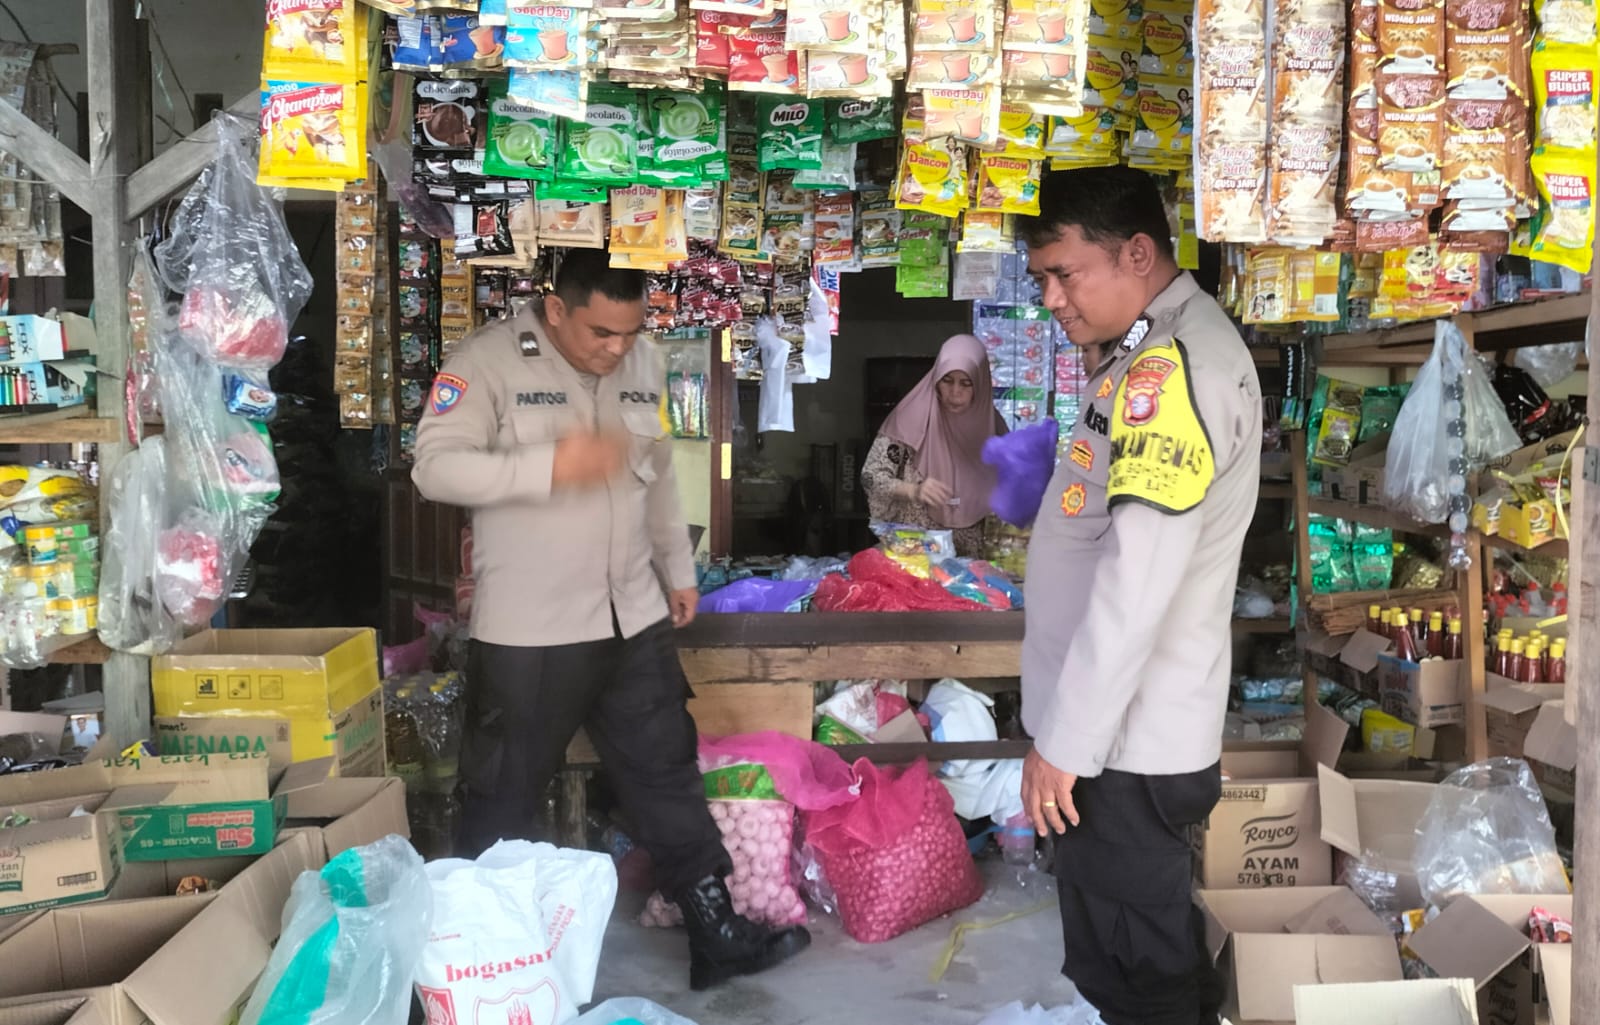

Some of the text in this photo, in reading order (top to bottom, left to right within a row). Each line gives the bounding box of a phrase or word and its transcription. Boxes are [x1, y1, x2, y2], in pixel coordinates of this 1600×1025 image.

[513, 6, 570, 20] Good Day
[1145, 25, 1184, 40] Dancow
[1311, 60, 1335, 71] JAHE
[1550, 71, 1587, 81] SUPER
[1548, 82, 1591, 92] BUBUR
[962, 89, 985, 103] Day
[1141, 100, 1179, 115] Dancow
[773, 110, 805, 122] MILO
[909, 151, 949, 169] Dancow
[987, 156, 1028, 170] Dancow
[1548, 175, 1584, 186] SUPER
[640, 185, 657, 198] Day
[743, 302, 802, 313] BC ABC
[161, 735, 266, 756] MENARA
[217, 828, 254, 848] SUN
[1243, 825, 1296, 845] Royco
[1244, 857, 1299, 870] AYAM
[1237, 873, 1260, 885] 576
[1275, 873, 1284, 885] 8
[1287, 875, 1296, 887] g
